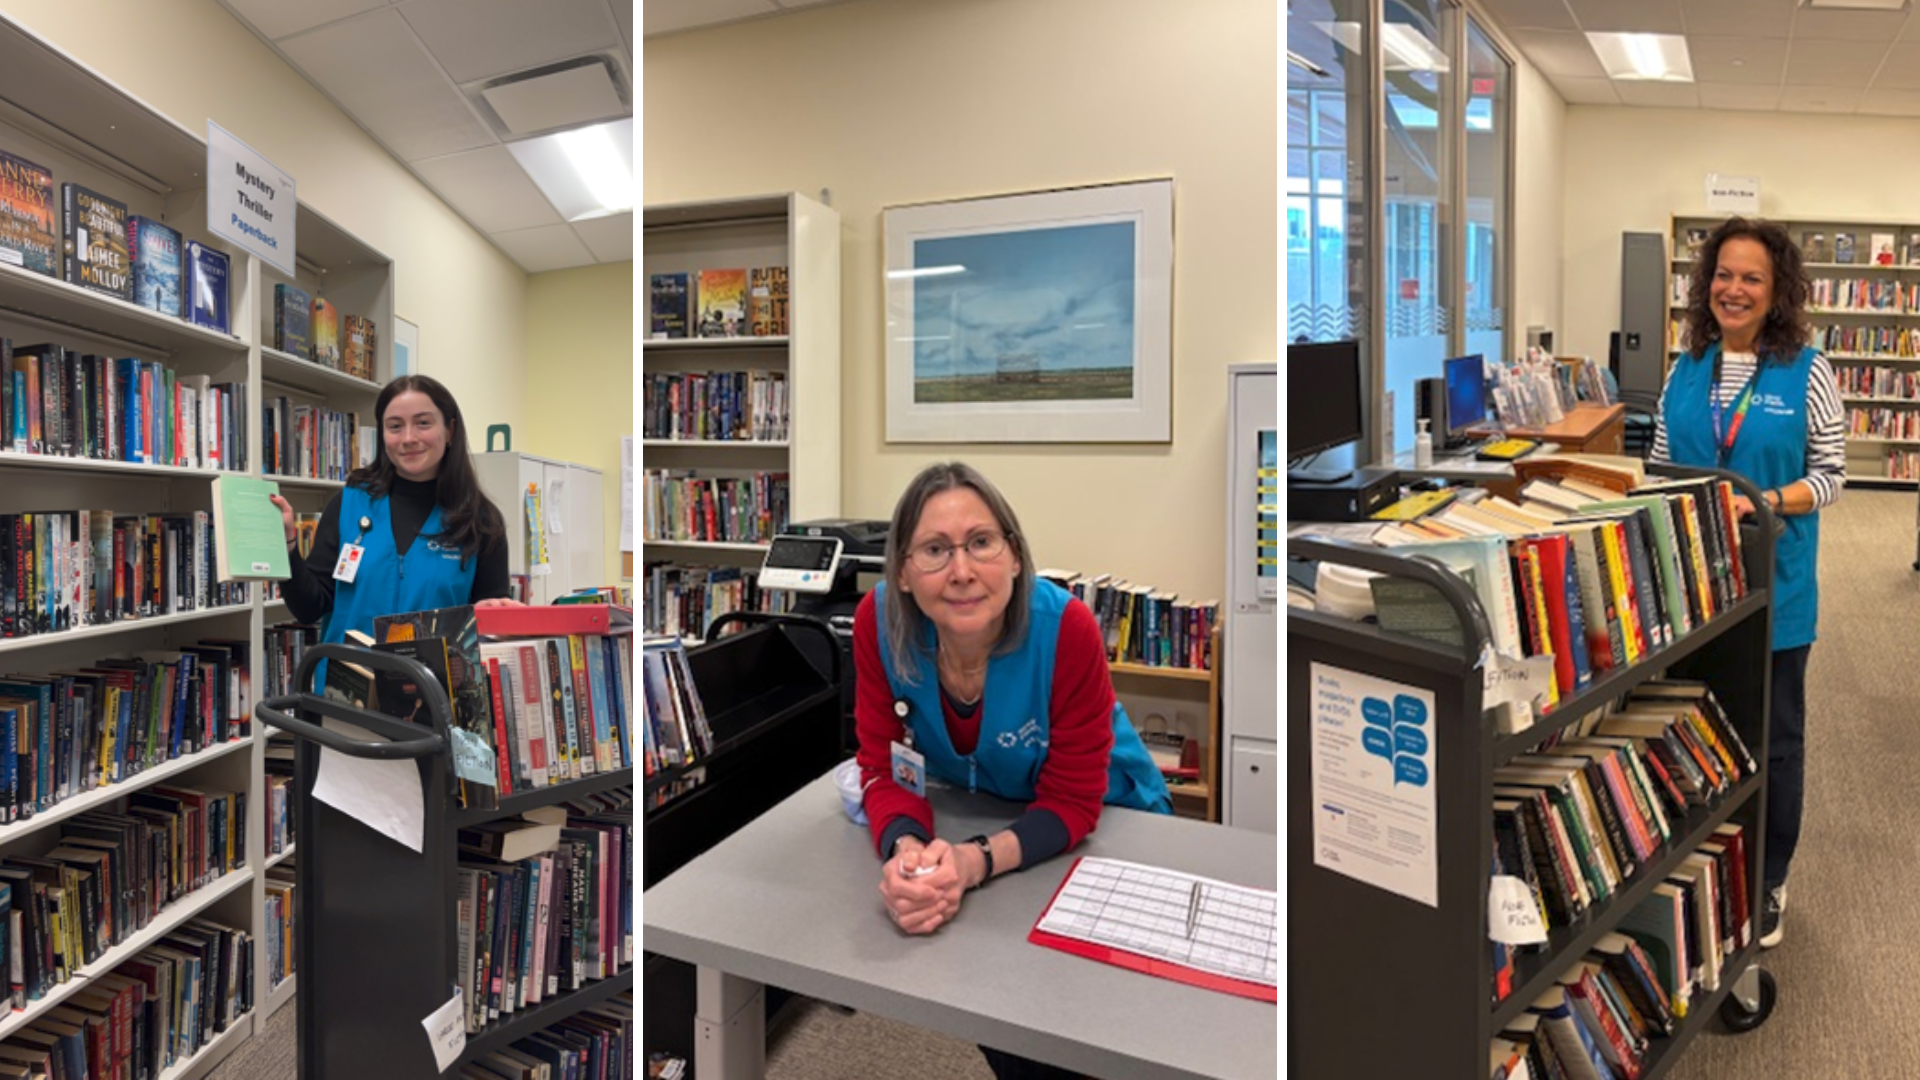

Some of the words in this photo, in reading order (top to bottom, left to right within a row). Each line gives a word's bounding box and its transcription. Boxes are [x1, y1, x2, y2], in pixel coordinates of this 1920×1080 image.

[235, 161, 276, 201] Mystery
[236, 189, 274, 223] Thriller
[230, 212, 279, 250] Paperback
[86, 243, 121, 270] AIMEE
[80, 264, 127, 290] MOLLOY
[751, 266, 789, 282] RUTH
[15, 518, 23, 546] TONY
[17, 549, 25, 600] PARSONS
